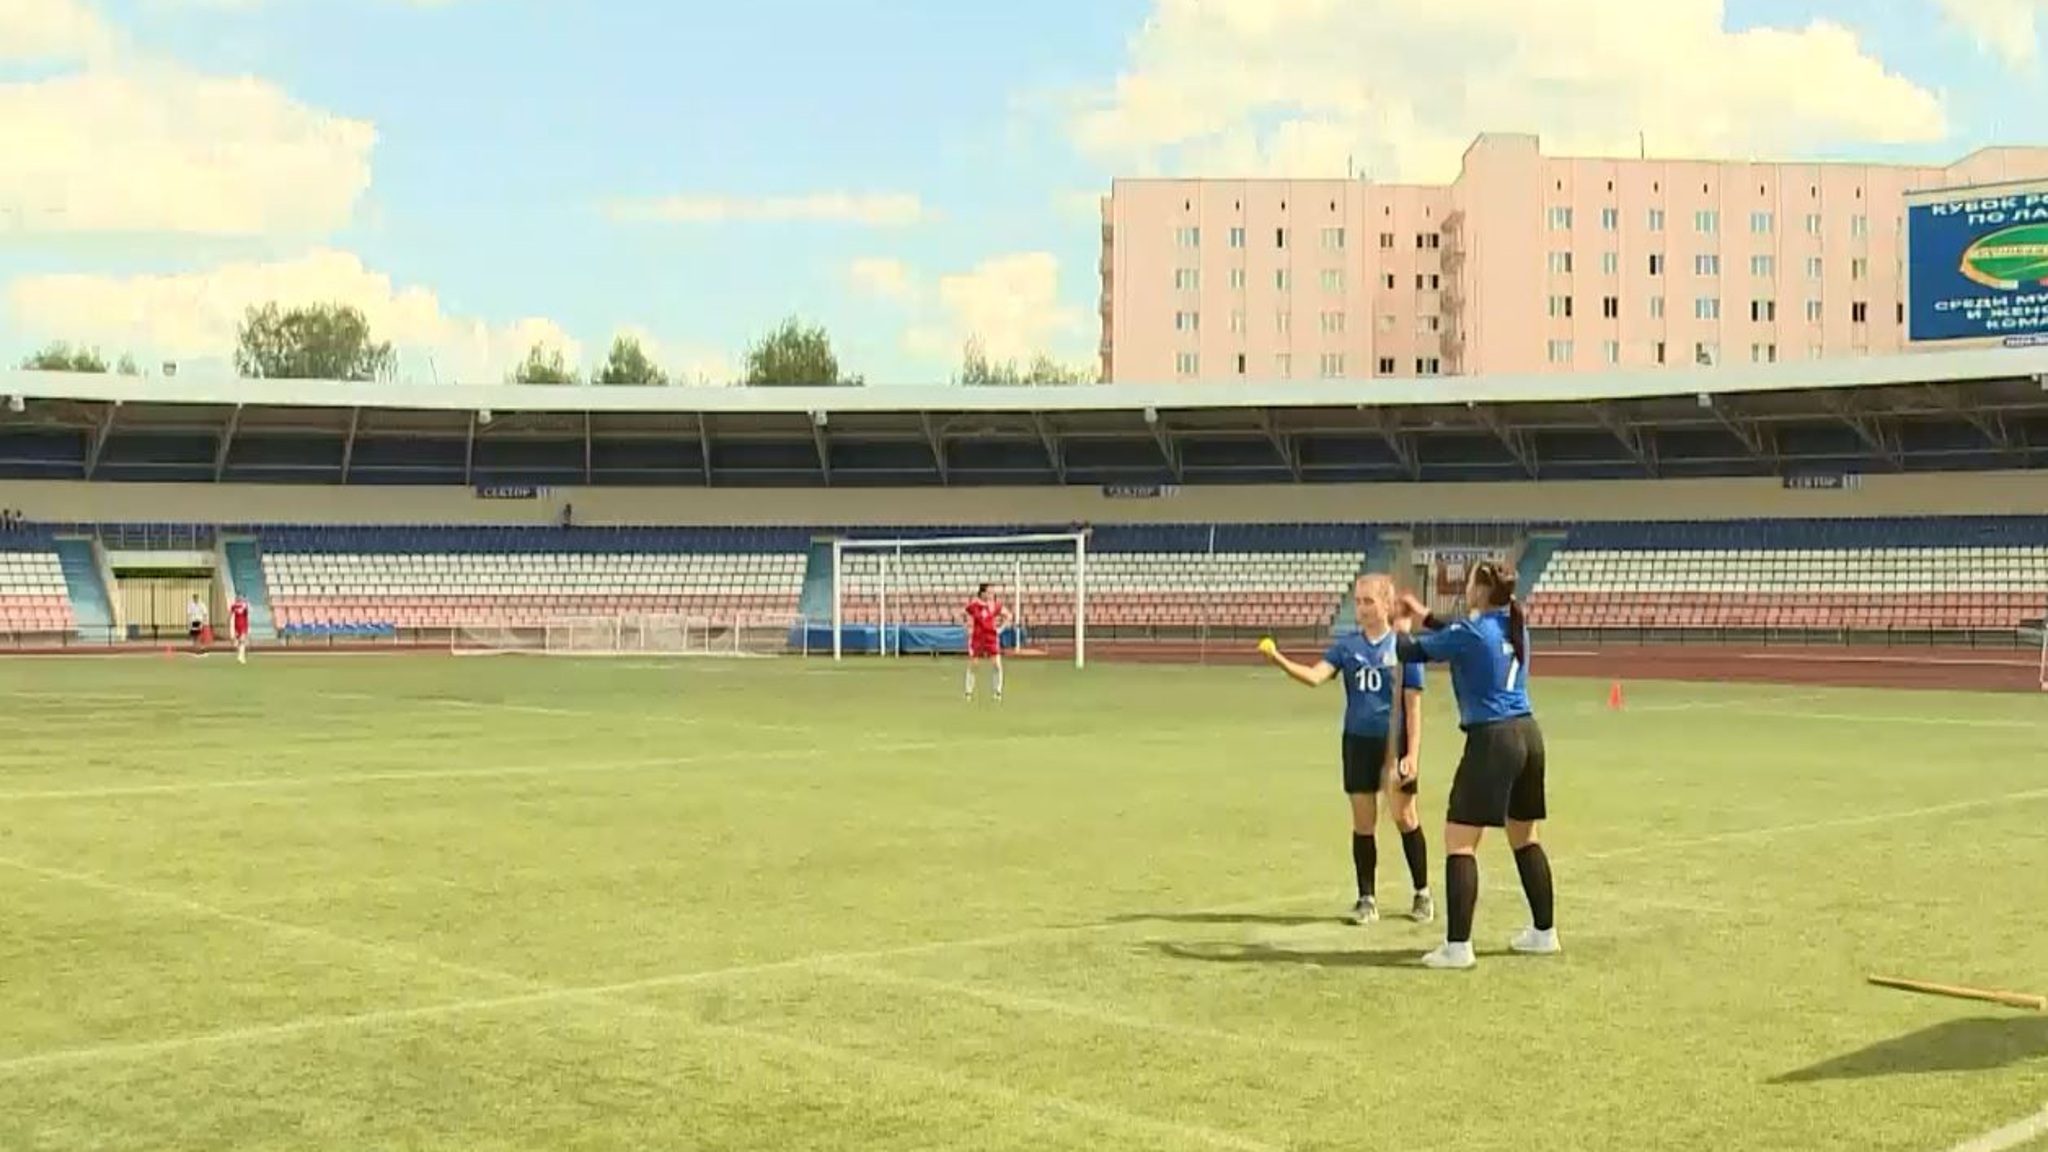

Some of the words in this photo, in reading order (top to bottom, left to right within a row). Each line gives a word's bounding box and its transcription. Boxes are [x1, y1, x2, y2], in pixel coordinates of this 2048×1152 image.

[1932, 196, 2018, 216] КУБОК
[1968, 211, 2005, 226] ПО
[1934, 295, 2009, 312] СРЕДИ
[1966, 309, 1982, 320] И
[1355, 667, 1382, 691] 10
